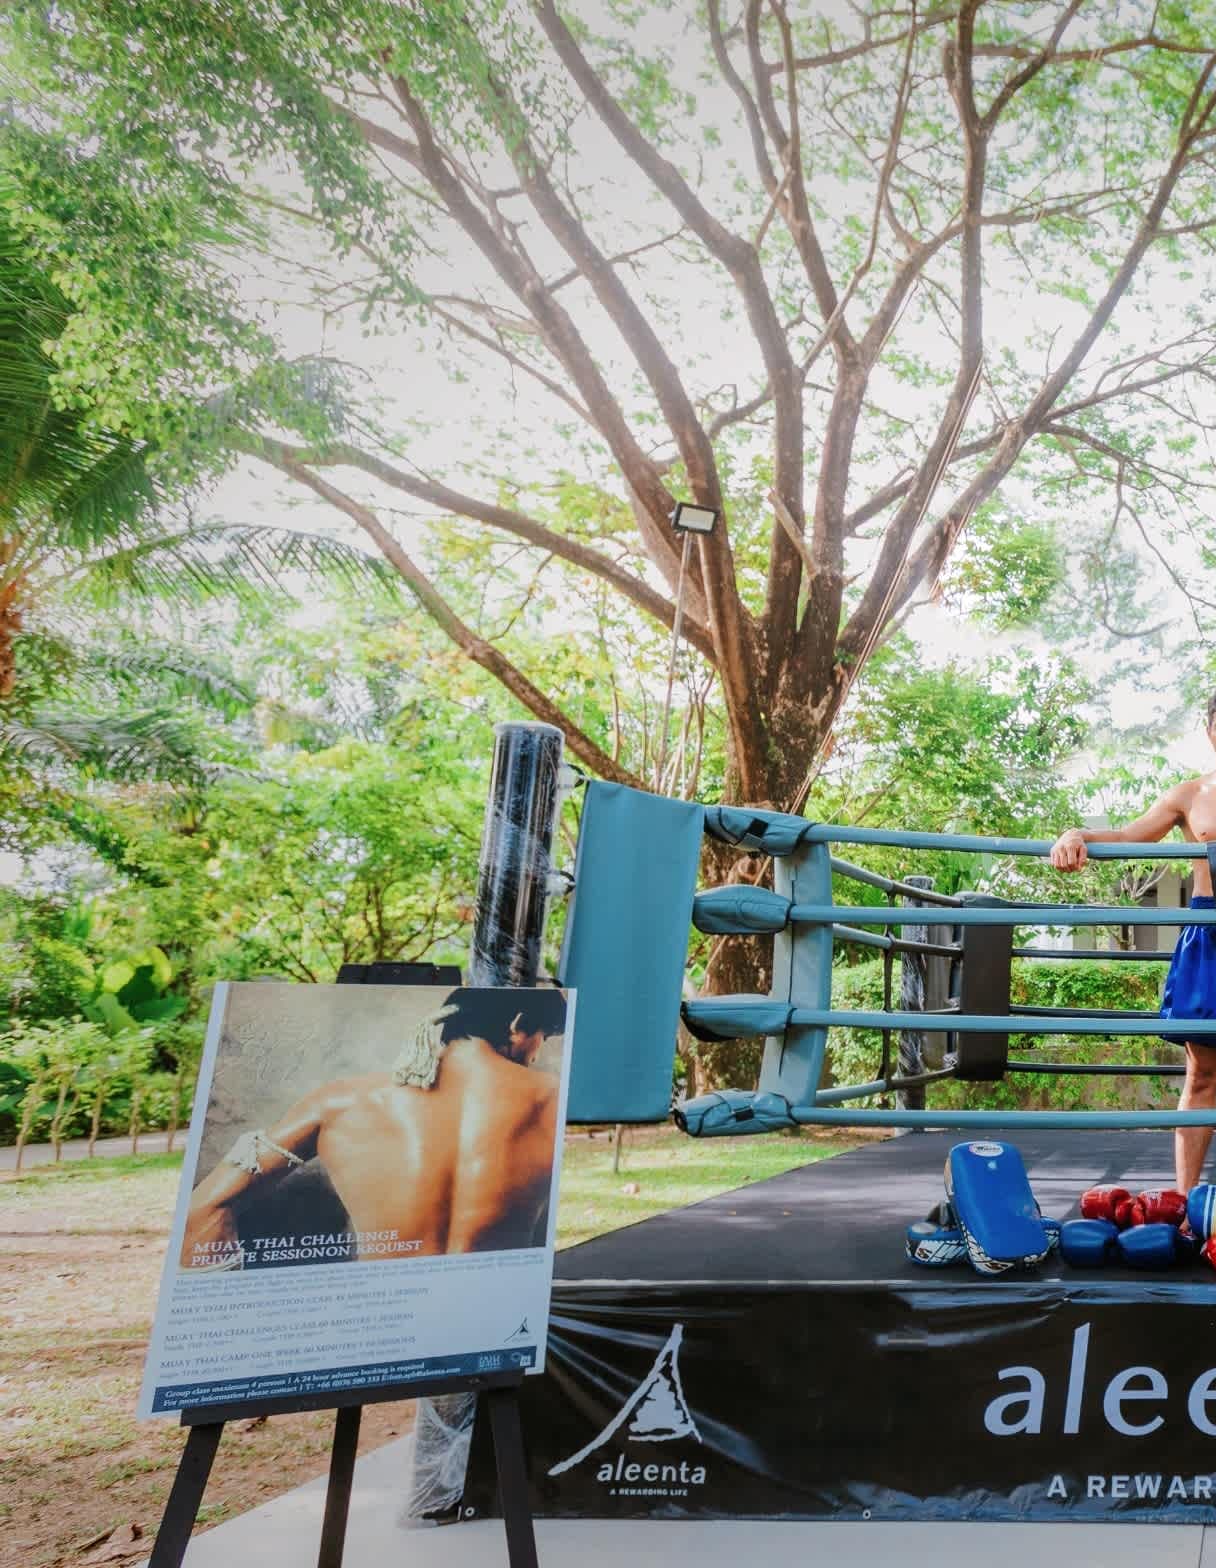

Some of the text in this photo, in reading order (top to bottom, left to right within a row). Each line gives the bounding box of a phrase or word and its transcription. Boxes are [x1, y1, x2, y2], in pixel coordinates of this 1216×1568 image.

[193, 1230, 400, 1254] MUAY THAI CHALLENGE
[191, 1239, 423, 1267] PRIVATE SESSIONON REQUEST
[160, 1359, 191, 1369] MUAY
[194, 1356, 220, 1367] THAI
[163, 1399, 177, 1407] For
[200, 1392, 245, 1402] information
[165, 1390, 191, 1398] Group
[596, 1454, 707, 1484] aleenta
[618, 1488, 668, 1497] REWARDING
[670, 1488, 688, 1497] LIFE
[1047, 1475, 1067, 1498] A
